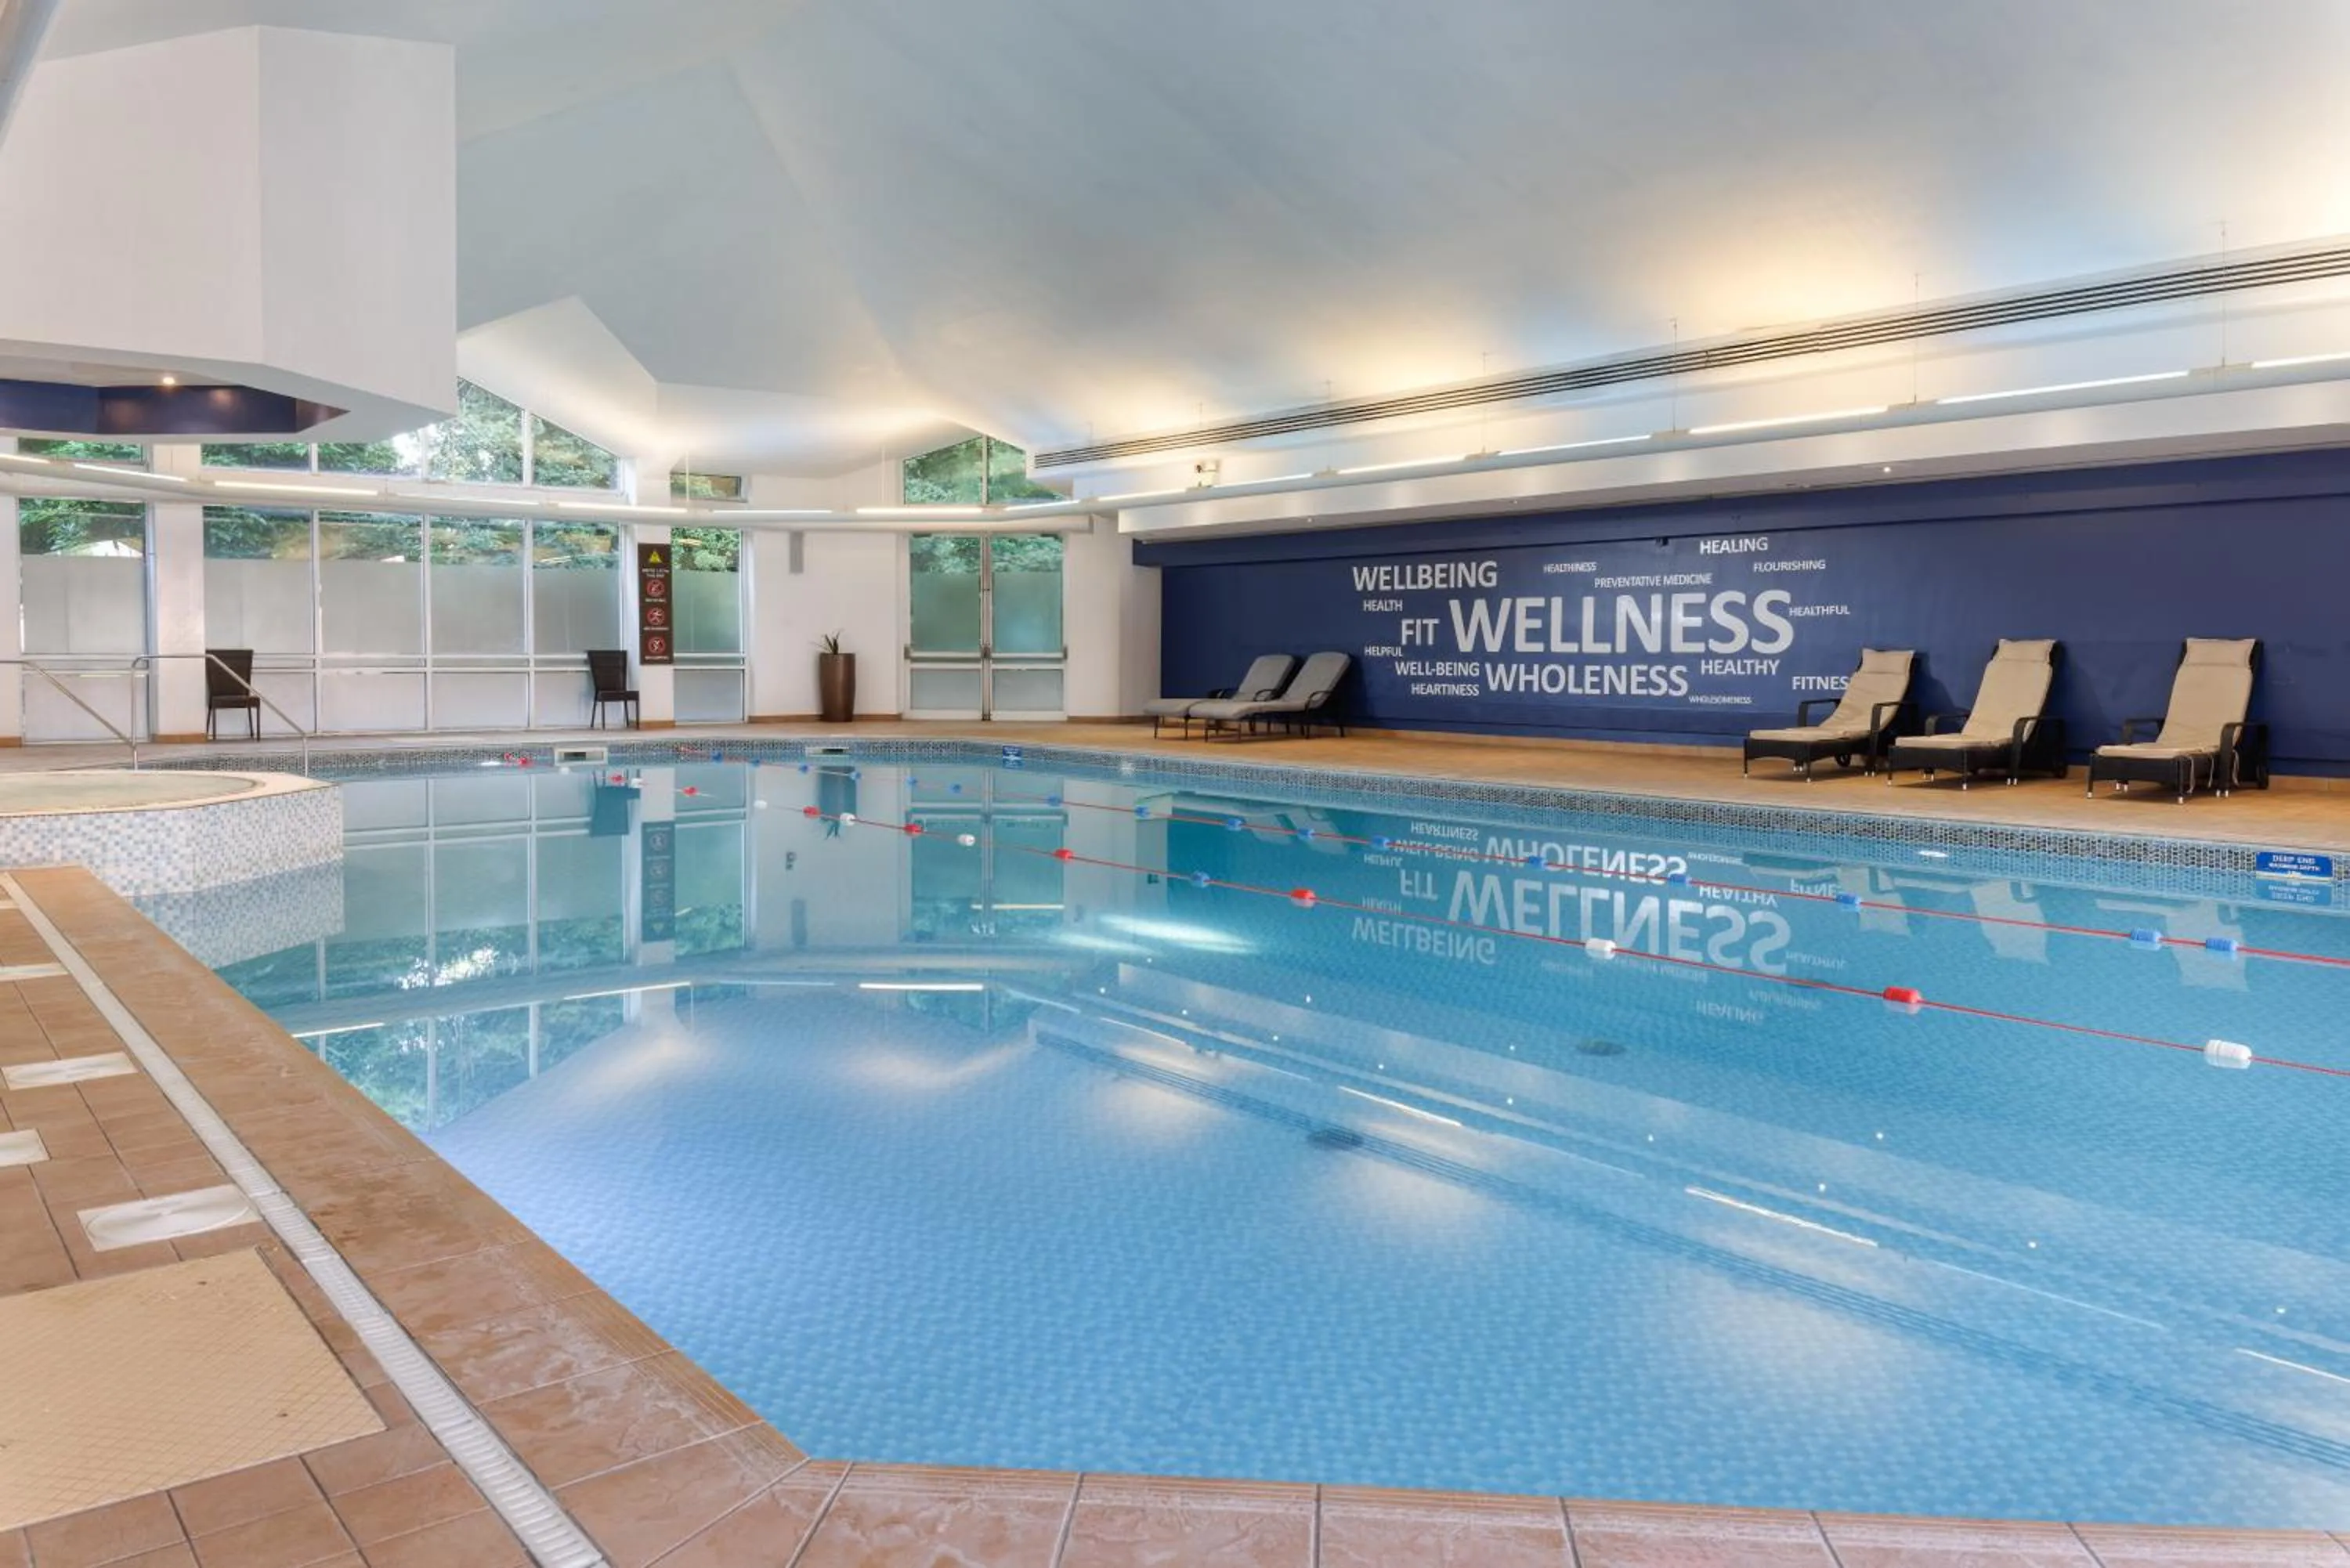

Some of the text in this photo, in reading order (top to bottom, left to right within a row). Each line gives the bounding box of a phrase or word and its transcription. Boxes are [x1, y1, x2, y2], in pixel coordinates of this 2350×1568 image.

[1699, 537, 1769, 555] HEALING
[1542, 562, 1597, 573] HEALTHINESS
[1753, 559, 1826, 573] FLOURISHING
[1353, 560, 1498, 591] WELLBEING
[1594, 573, 1713, 588] PREVENTATIVE MEDICINE
[1363, 599, 1403, 612] HEALTH
[1788, 605, 1850, 616] HEALTHFUL
[1448, 590, 1794, 654] WELLNESS
[1401, 619, 1440, 645] FIT
[1365, 645, 1403, 656] HELPFUL
[1395, 661, 1480, 677] WELL-BEING
[1701, 659, 1780, 676] HEALTHY
[1485, 663, 1689, 696] WHOLENESS
[1791, 676, 1850, 690] FITNES
[1411, 683, 1480, 696] HEARTINESS
